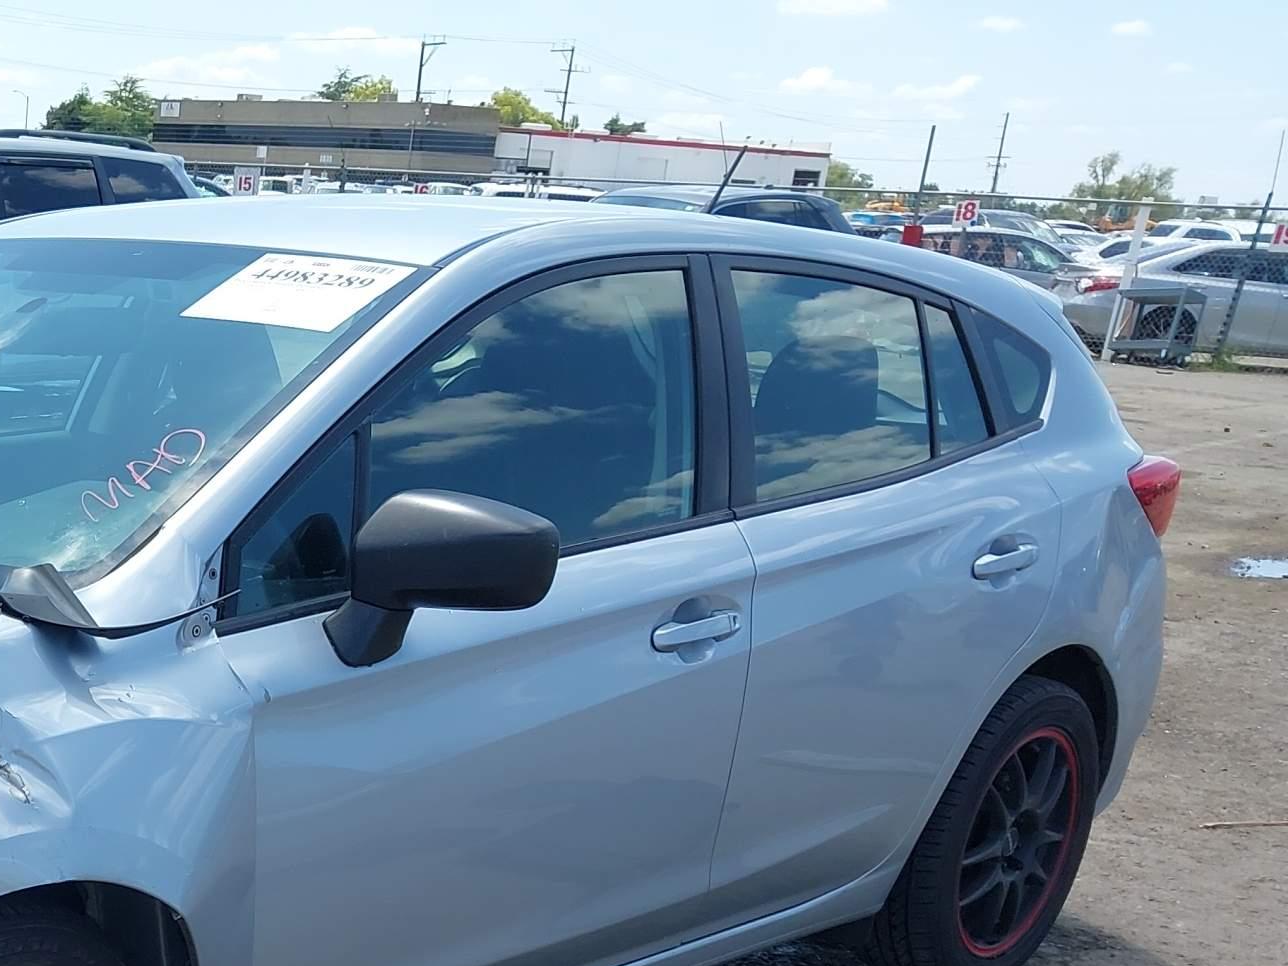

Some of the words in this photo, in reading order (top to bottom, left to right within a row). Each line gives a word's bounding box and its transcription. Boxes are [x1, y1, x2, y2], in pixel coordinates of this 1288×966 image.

[238, 176, 253, 191] 15
[956, 202, 976, 221] 18
[252, 268, 376, 290] 44983289
